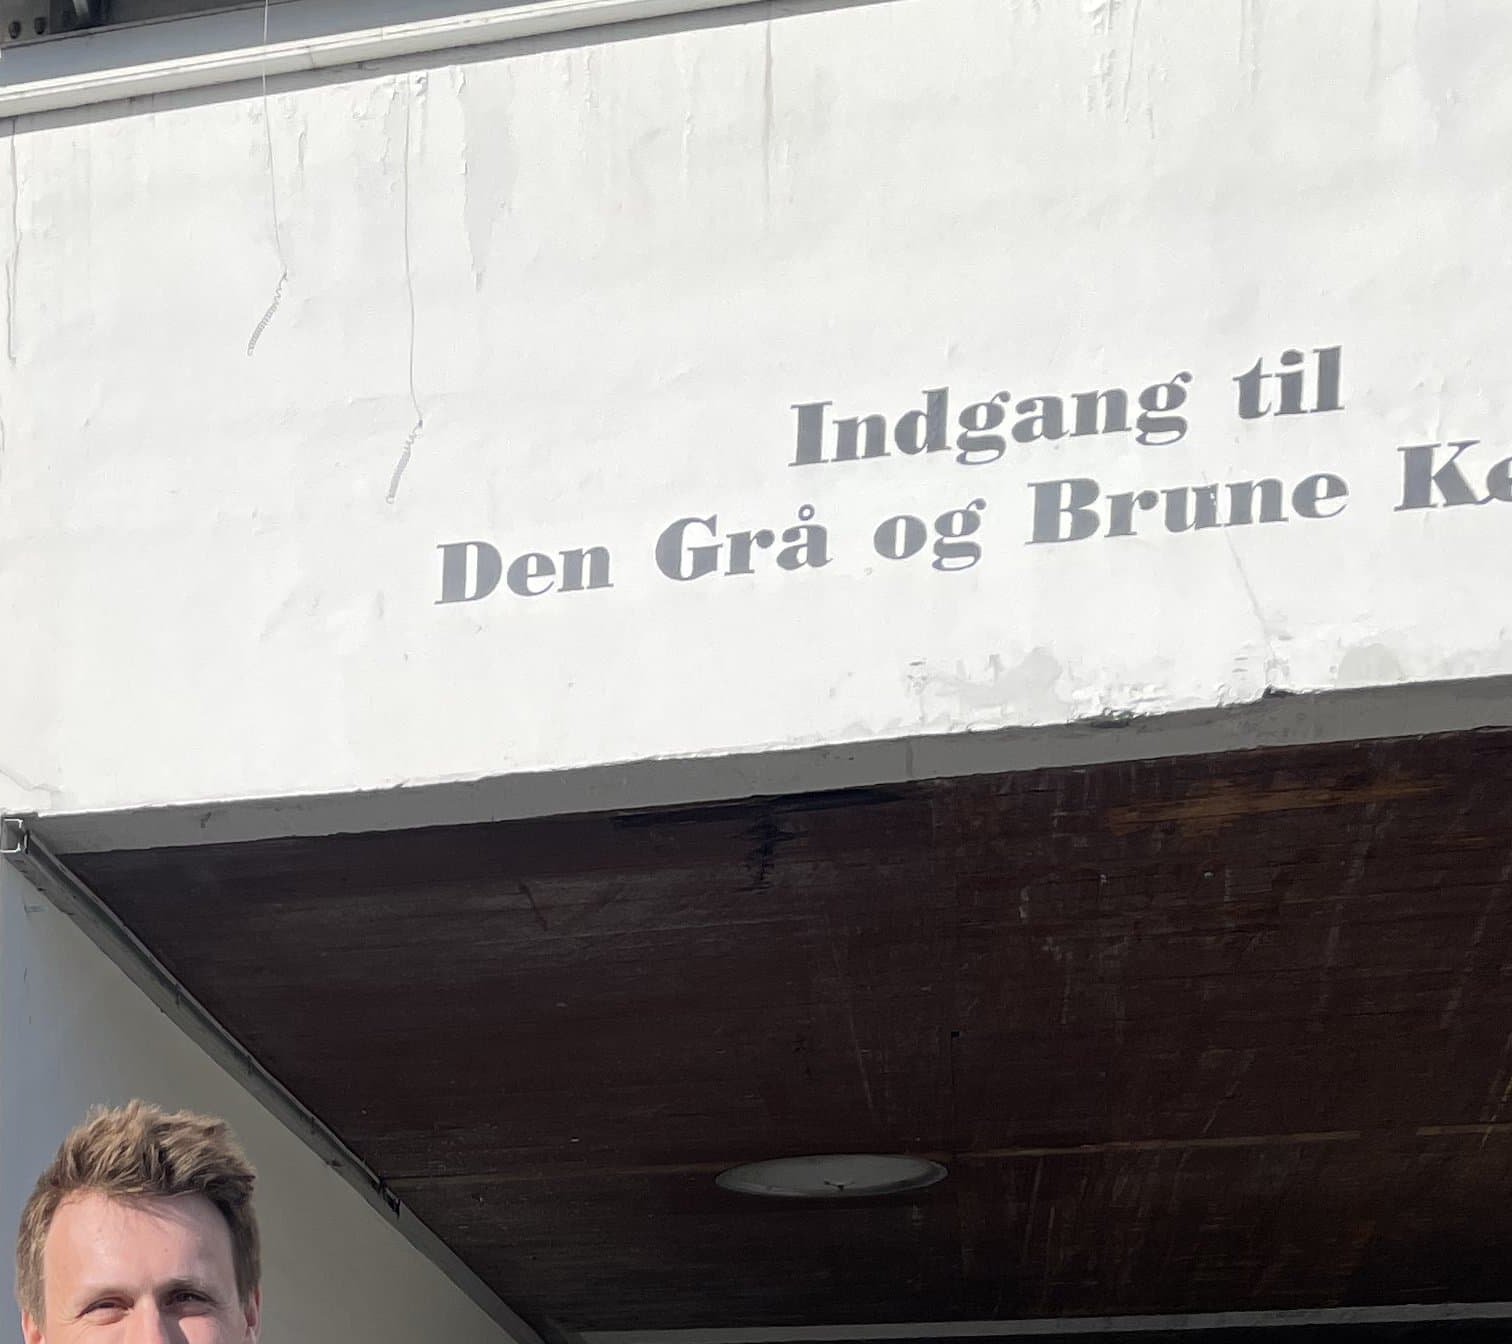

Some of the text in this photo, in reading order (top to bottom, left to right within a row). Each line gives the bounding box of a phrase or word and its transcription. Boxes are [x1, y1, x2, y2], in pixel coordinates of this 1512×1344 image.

[787, 345, 1345, 466] Indgang til
[433, 541, 615, 605] Den
[654, 503, 831, 582] Grå
[873, 498, 987, 572] og
[1024, 473, 1350, 545] Brune
